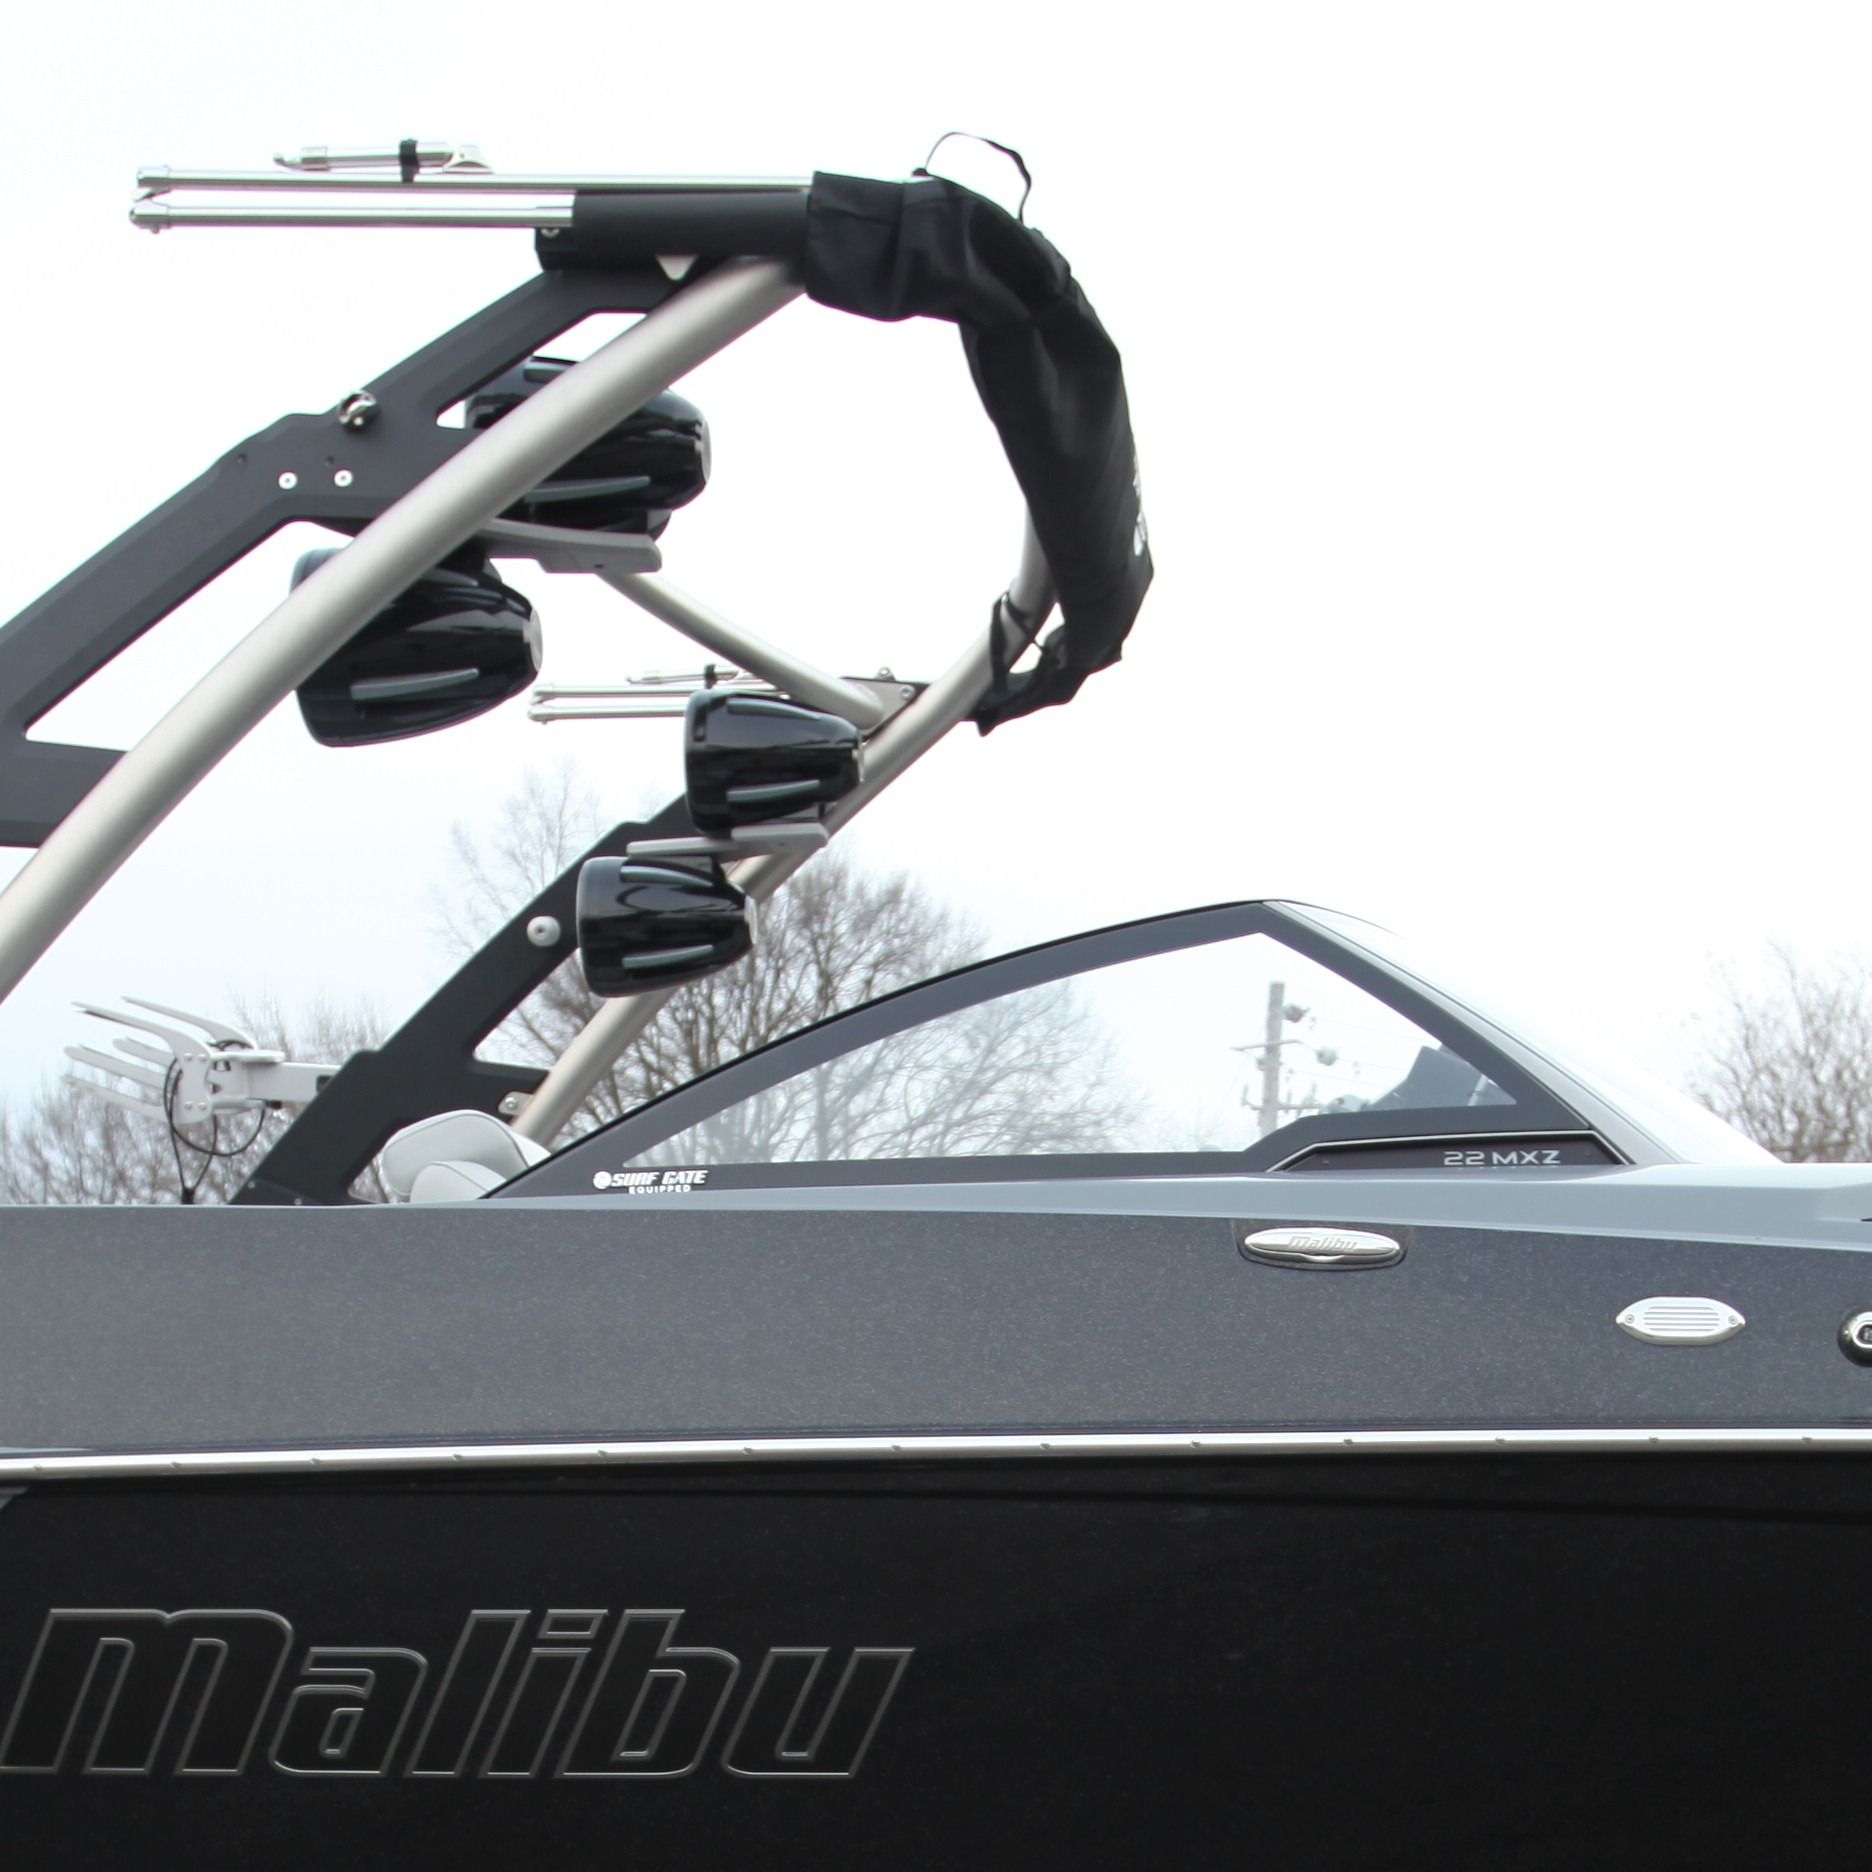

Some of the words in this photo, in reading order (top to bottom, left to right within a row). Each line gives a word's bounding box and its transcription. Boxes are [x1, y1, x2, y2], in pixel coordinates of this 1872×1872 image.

[1443, 1151, 1486, 1166] 22
[1491, 1150, 1561, 1165] MXZ
[661, 1170, 708, 1185] GATE
[628, 1184, 692, 1195] EQUIPPED
